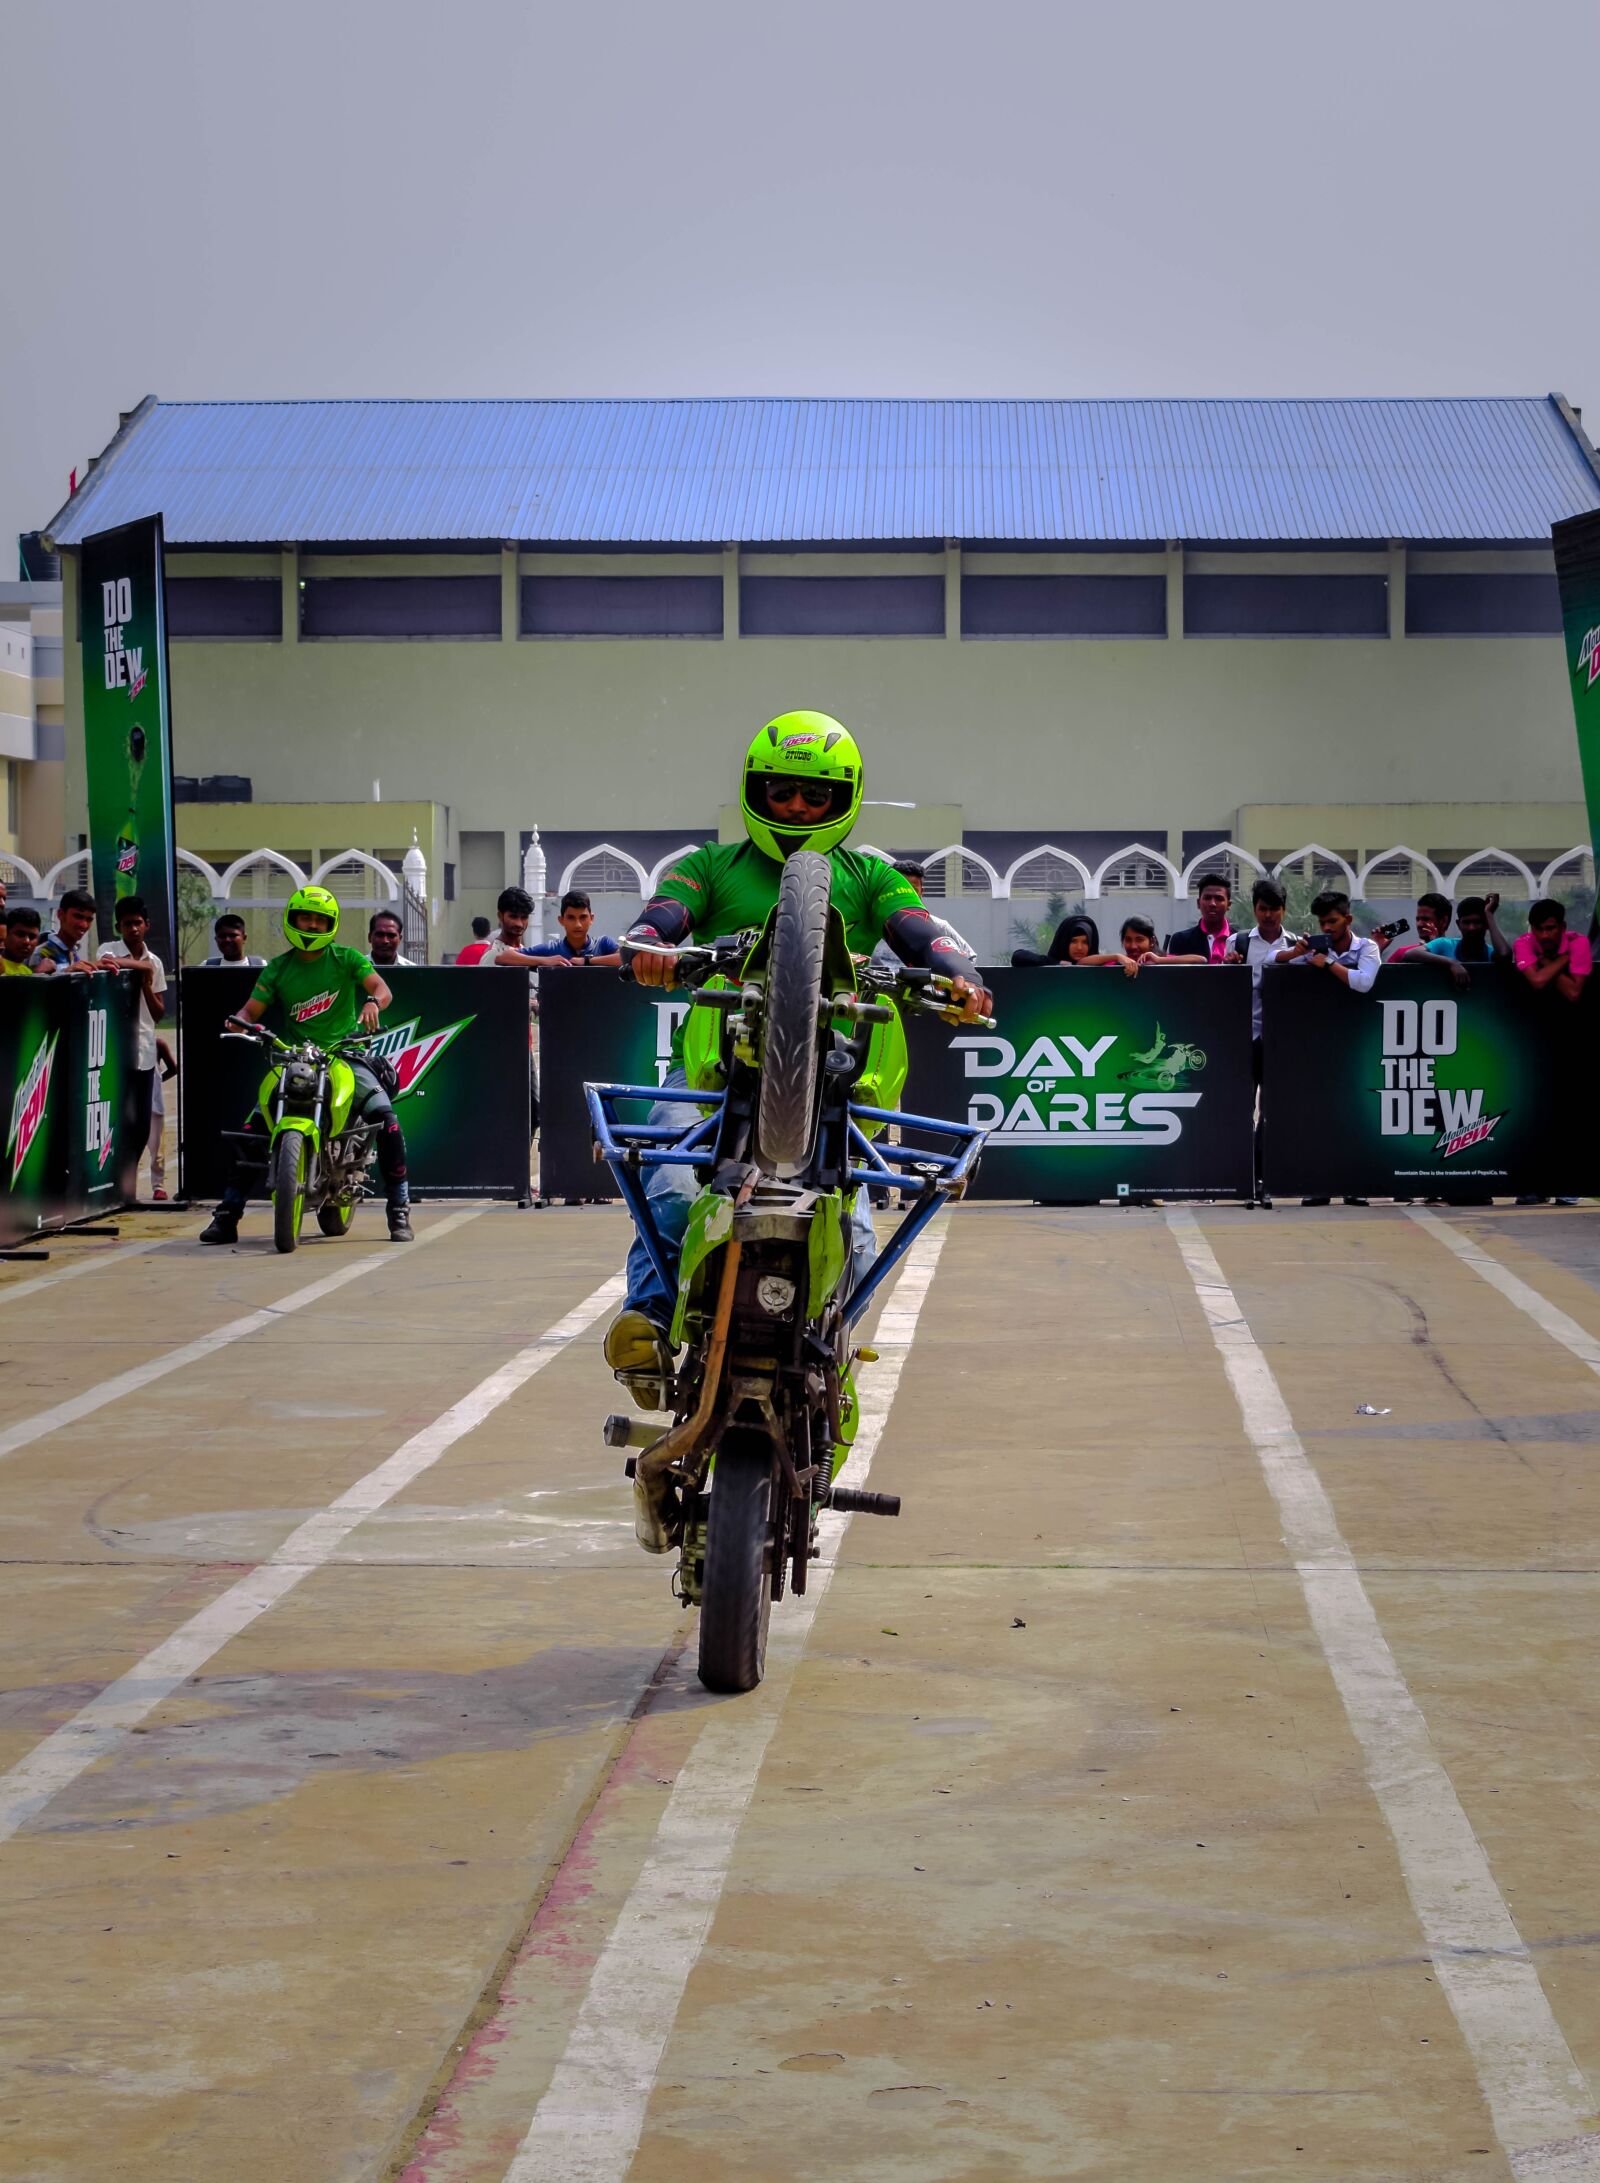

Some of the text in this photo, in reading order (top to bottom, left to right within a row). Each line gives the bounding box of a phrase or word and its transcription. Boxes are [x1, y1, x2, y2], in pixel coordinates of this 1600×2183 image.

[101, 577, 132, 626] DO
[104, 626, 124, 652] THE
[104, 647, 142, 689] DEW
[88, 1009, 107, 1068] DO
[1376, 1000, 1458, 1056] DO
[948, 1036, 1118, 1077] DAY
[1381, 1058, 1435, 1088] THE
[88, 1070, 100, 1102] THE
[1026, 1079, 1057, 1093] OF
[86, 1101, 110, 1152] DEW
[968, 1092, 1203, 1145] DARES
[1376, 1089, 1484, 1135] DEW
[1442, 1118, 1485, 1144] Mountain
